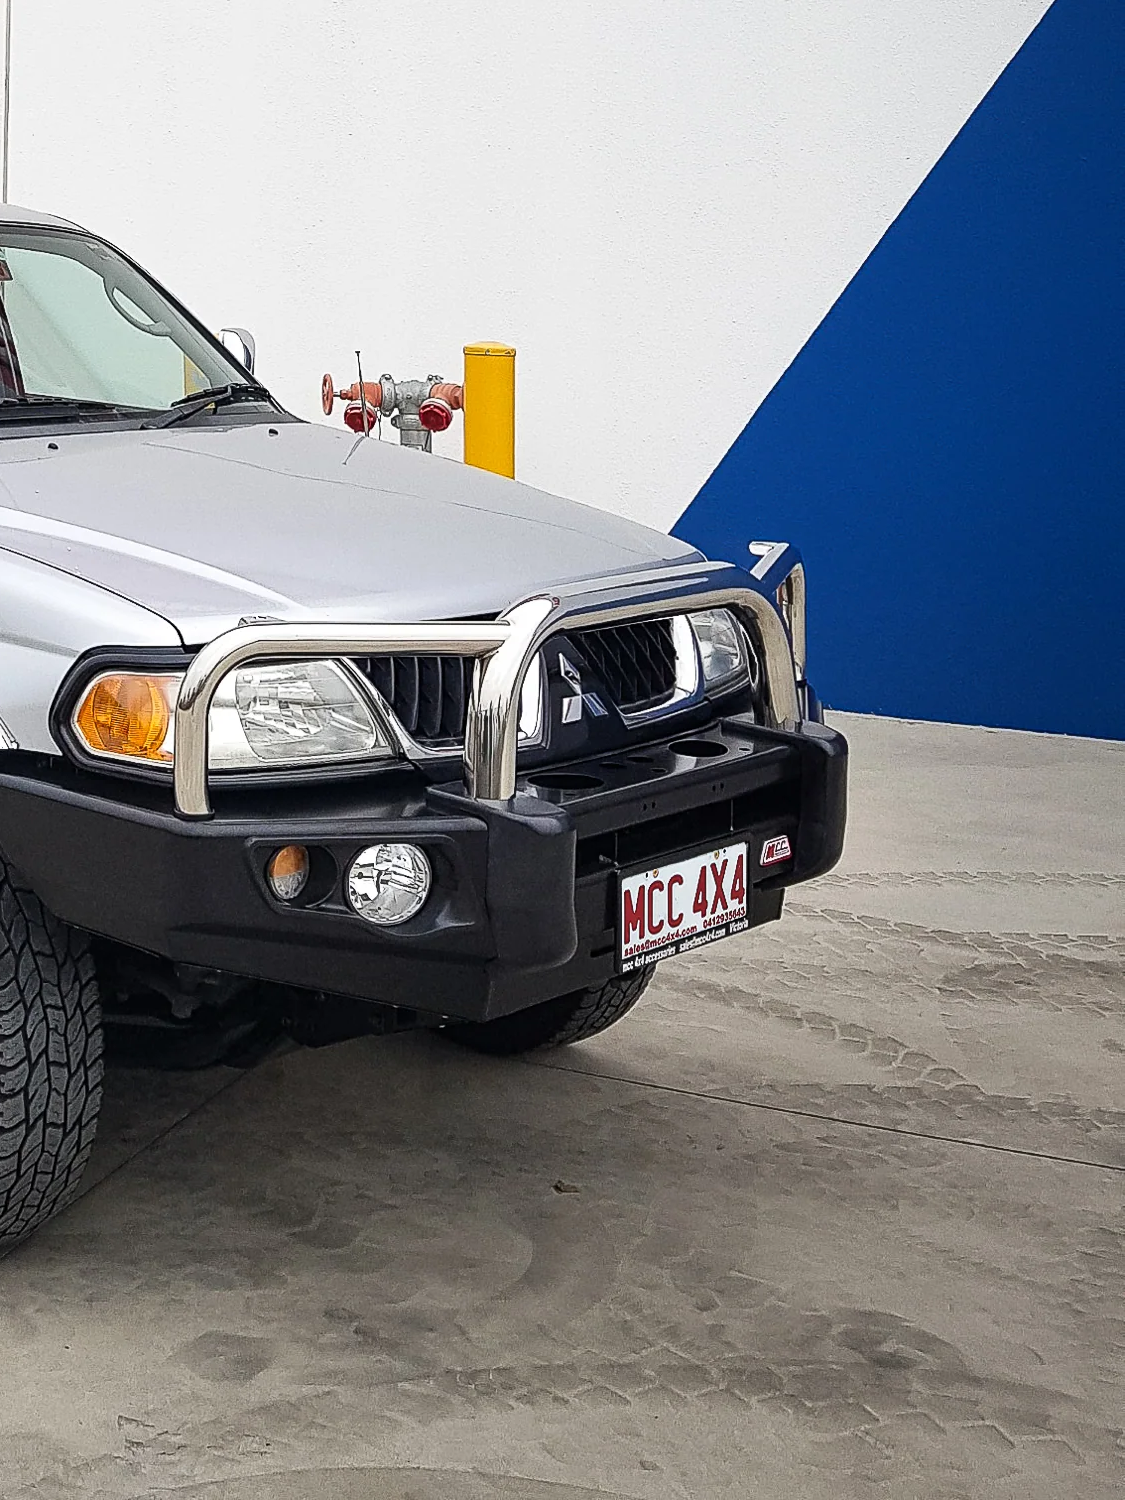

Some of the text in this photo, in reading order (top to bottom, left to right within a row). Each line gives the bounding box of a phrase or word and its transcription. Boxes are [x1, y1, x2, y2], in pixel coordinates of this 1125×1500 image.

[623, 853, 745, 945] MCC 4X4
[623, 925, 698, 957] sales@mcc4x4.com
[729, 918, 749, 934] Victoria
